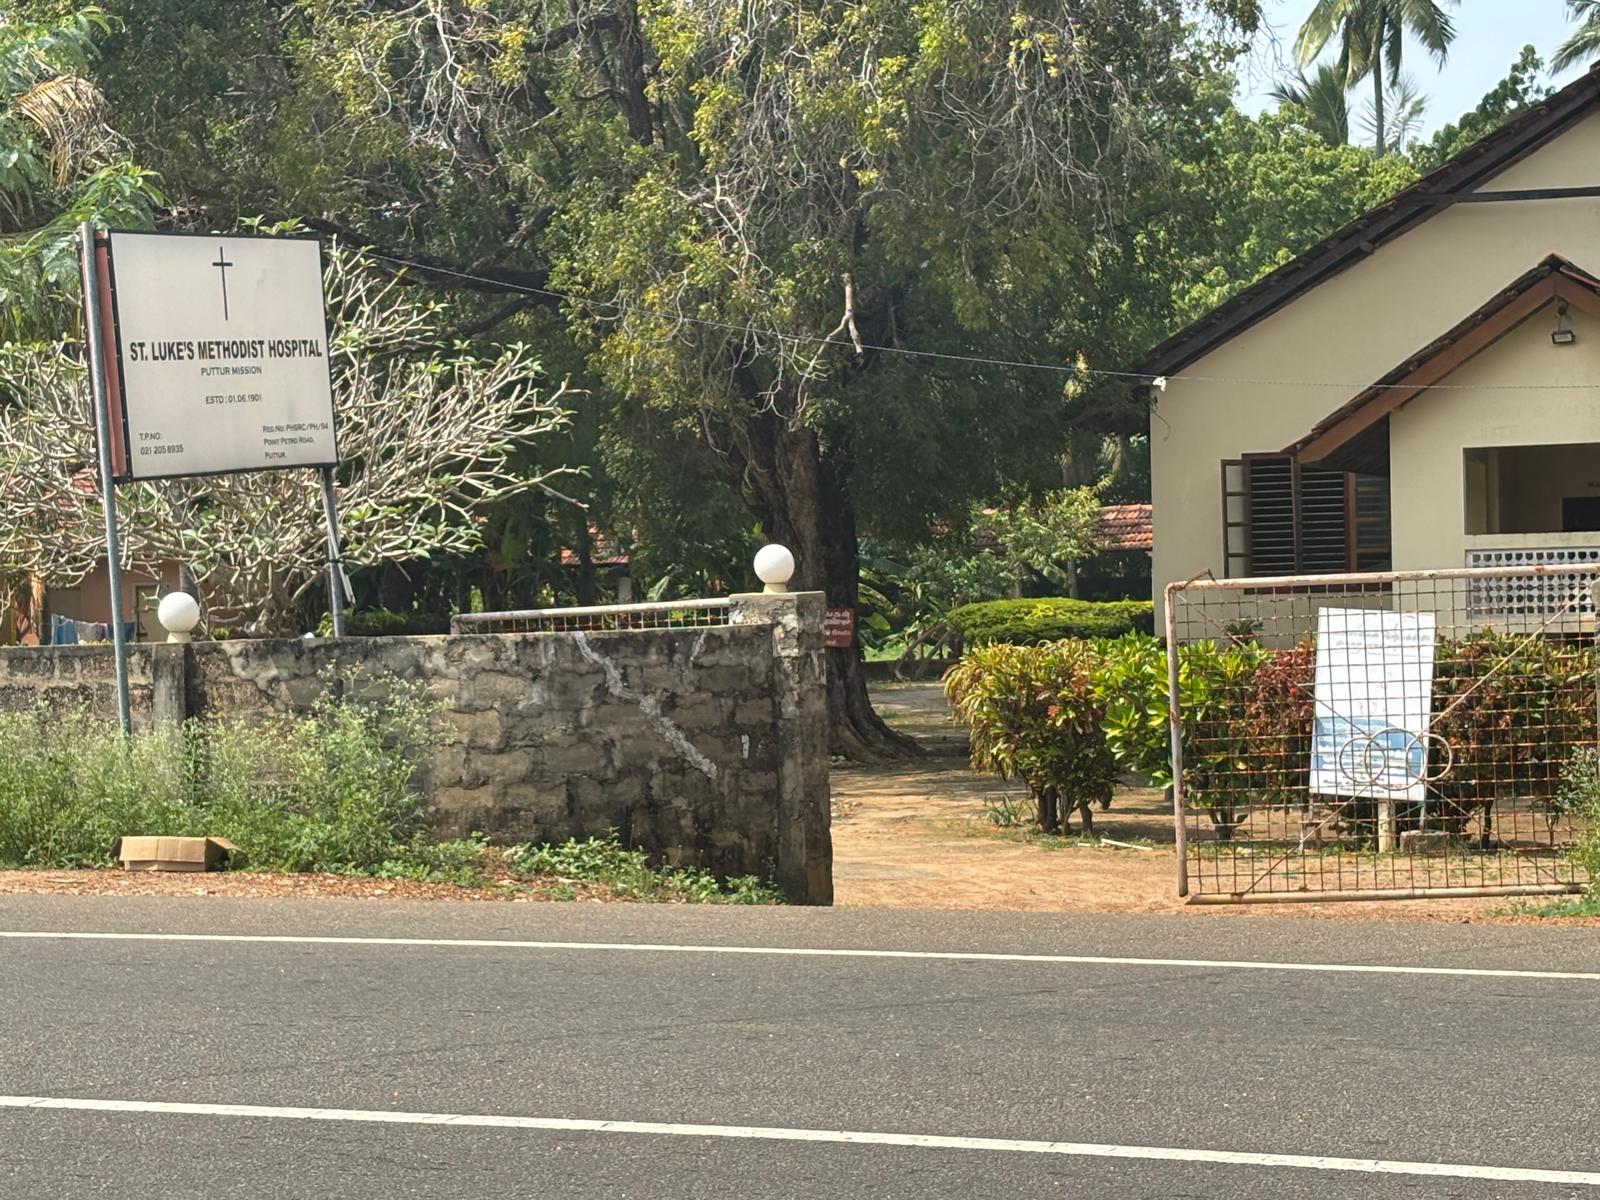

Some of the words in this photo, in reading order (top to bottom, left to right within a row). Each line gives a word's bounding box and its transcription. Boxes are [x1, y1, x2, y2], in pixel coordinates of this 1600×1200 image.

[130, 341, 148, 361] ST.
[152, 341, 195, 361] LUKE'S
[198, 340, 265, 360] METHODIST
[269, 339, 322, 359] HOSPITAL
[201, 367, 230, 376] PUTTUR
[232, 366, 262, 375] MISSION
[140, 446, 152, 455] 021
[154, 445, 166, 455] 205
